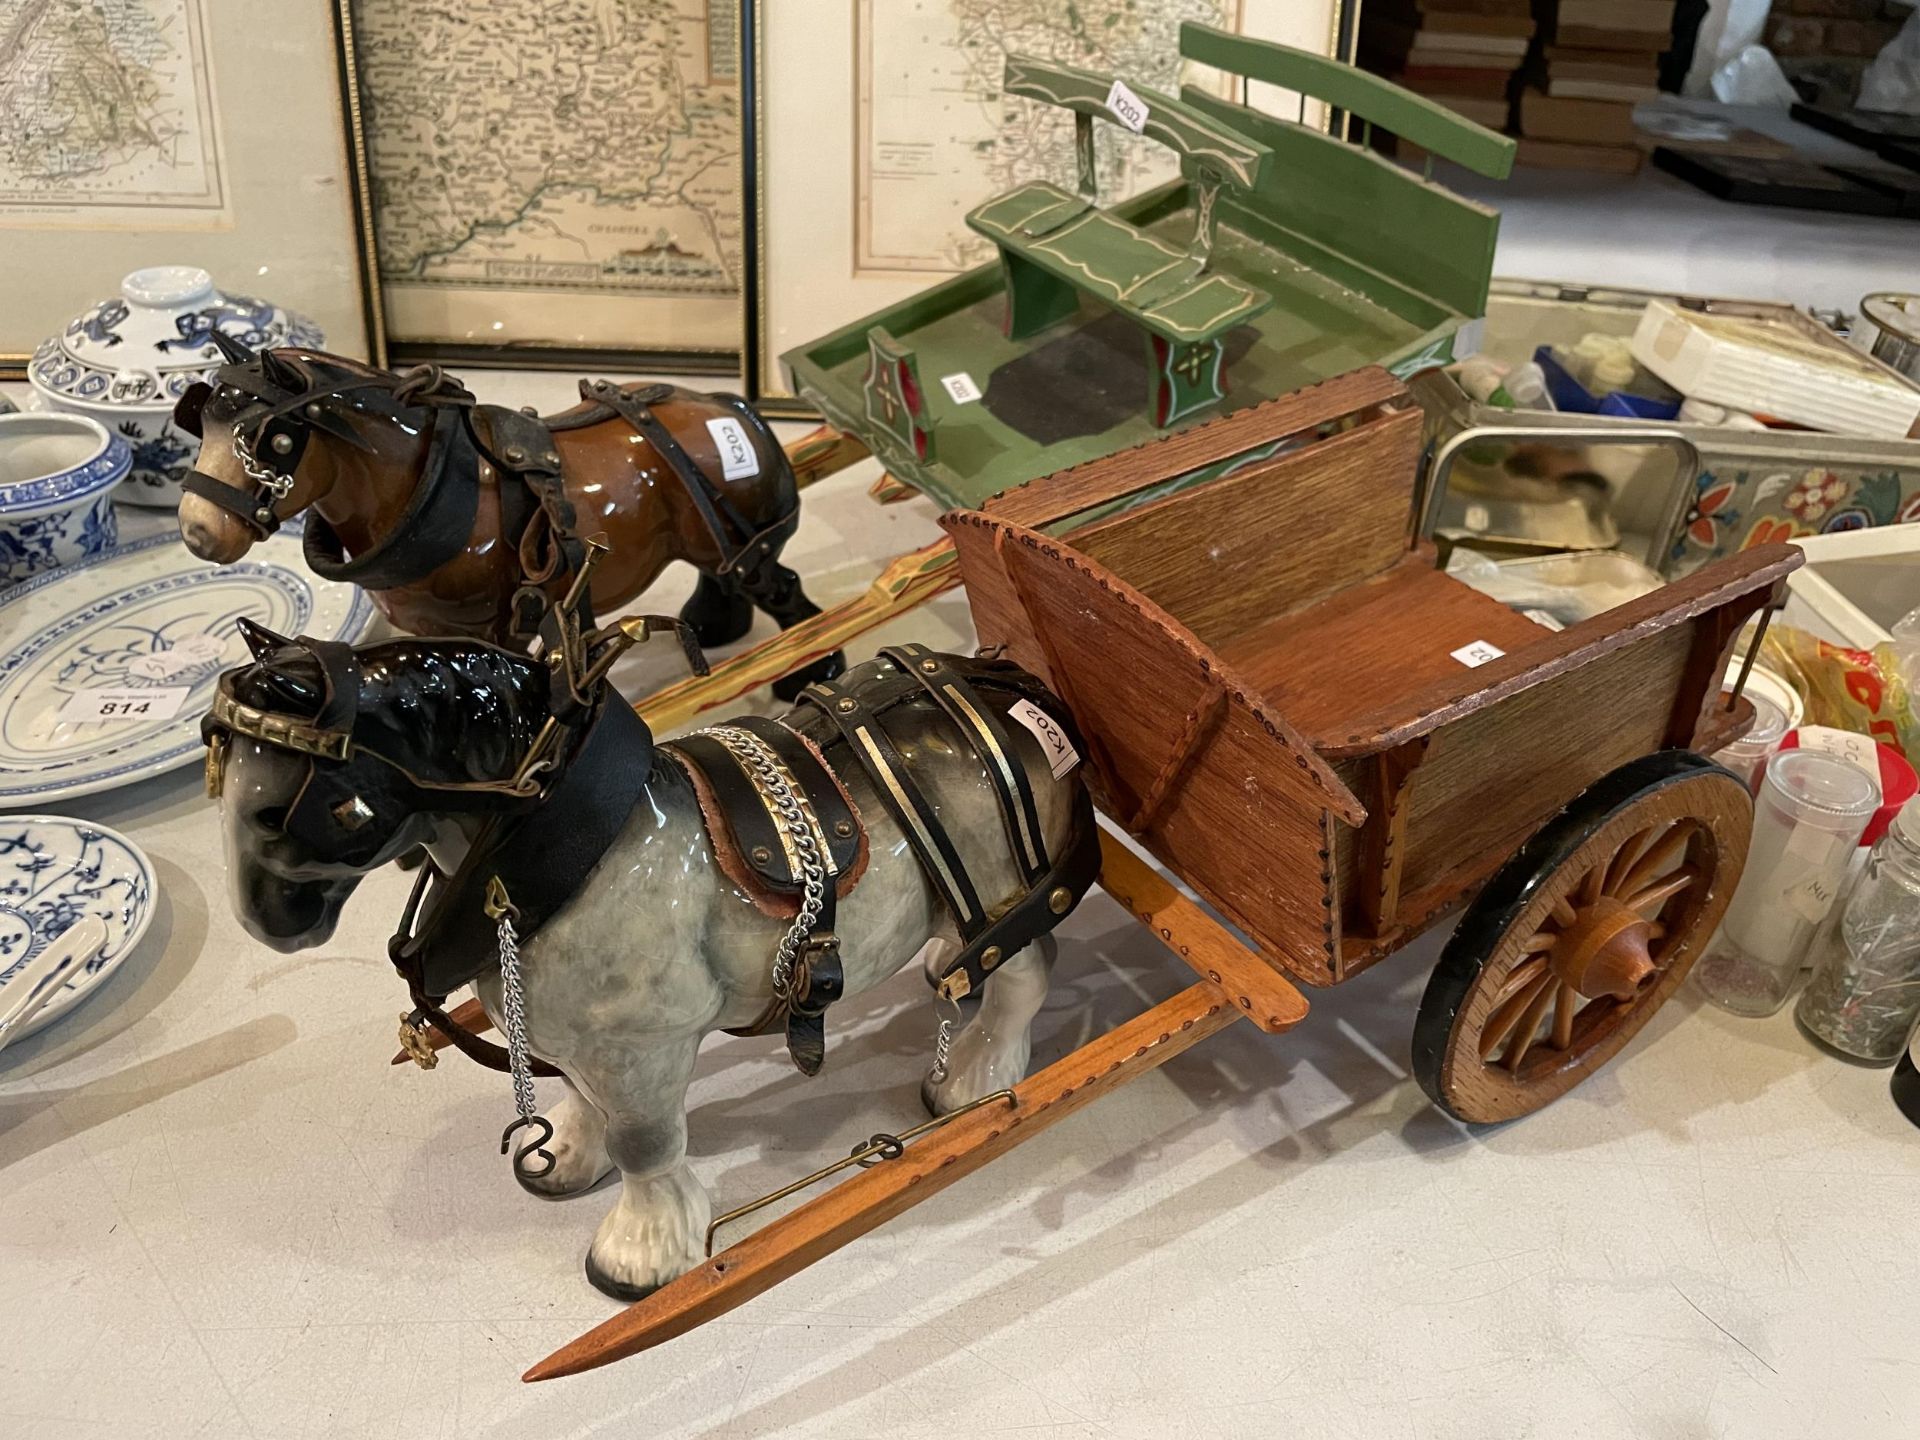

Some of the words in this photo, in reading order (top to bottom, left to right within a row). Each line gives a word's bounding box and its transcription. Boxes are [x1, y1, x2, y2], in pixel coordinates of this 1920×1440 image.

[1115, 95, 1140, 127] K202
[722, 426, 747, 464] K202
[99, 702, 151, 715] 814
[1026, 707, 1065, 754] K202
